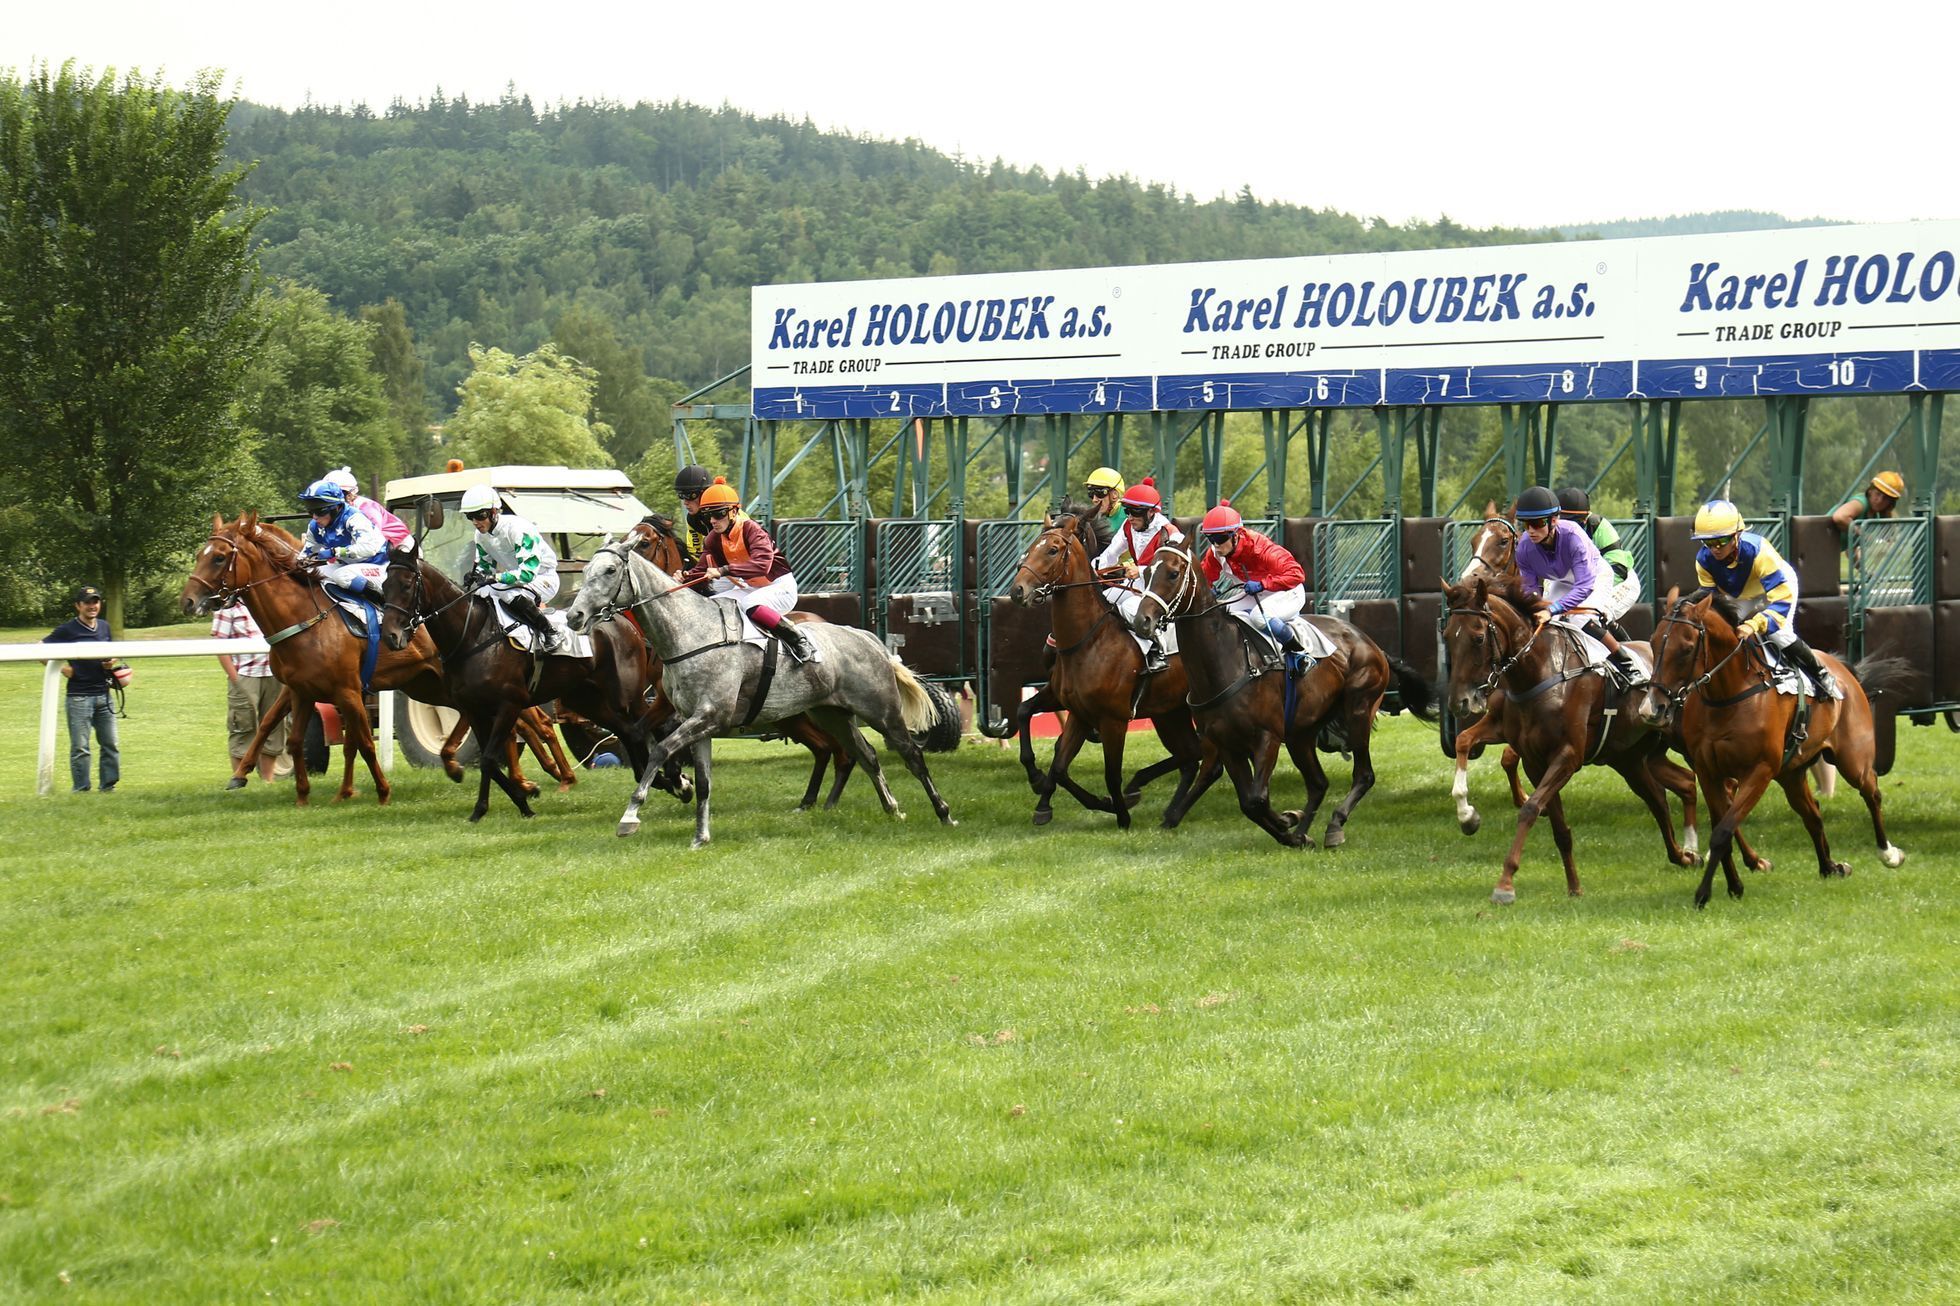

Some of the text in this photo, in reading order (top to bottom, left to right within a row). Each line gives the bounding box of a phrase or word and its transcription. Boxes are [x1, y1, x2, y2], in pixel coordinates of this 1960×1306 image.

[1679, 250, 1960, 313] Karel HOLO
[1182, 273, 1595, 333] Karel HOLOUBEK a.s.
[768, 295, 1112, 350] Karel HOLOUBEK a.s.
[1715, 321, 1842, 342] TRADE GROUP
[1212, 342, 1316, 360] TRADE GROUP
[793, 358, 881, 375] TRADE GROUP
[1693, 365, 1708, 390] 9
[1827, 360, 1855, 386] 10
[1202, 381, 1215, 403] 5
[1316, 377, 1329, 400] 6
[1438, 374, 1451, 397] 7
[1561, 369, 1575, 393] 8
[794, 393, 803, 414] 1
[889, 390, 901, 412] 2
[989, 386, 1001, 409] 3
[1094, 384, 1106, 406] 4
